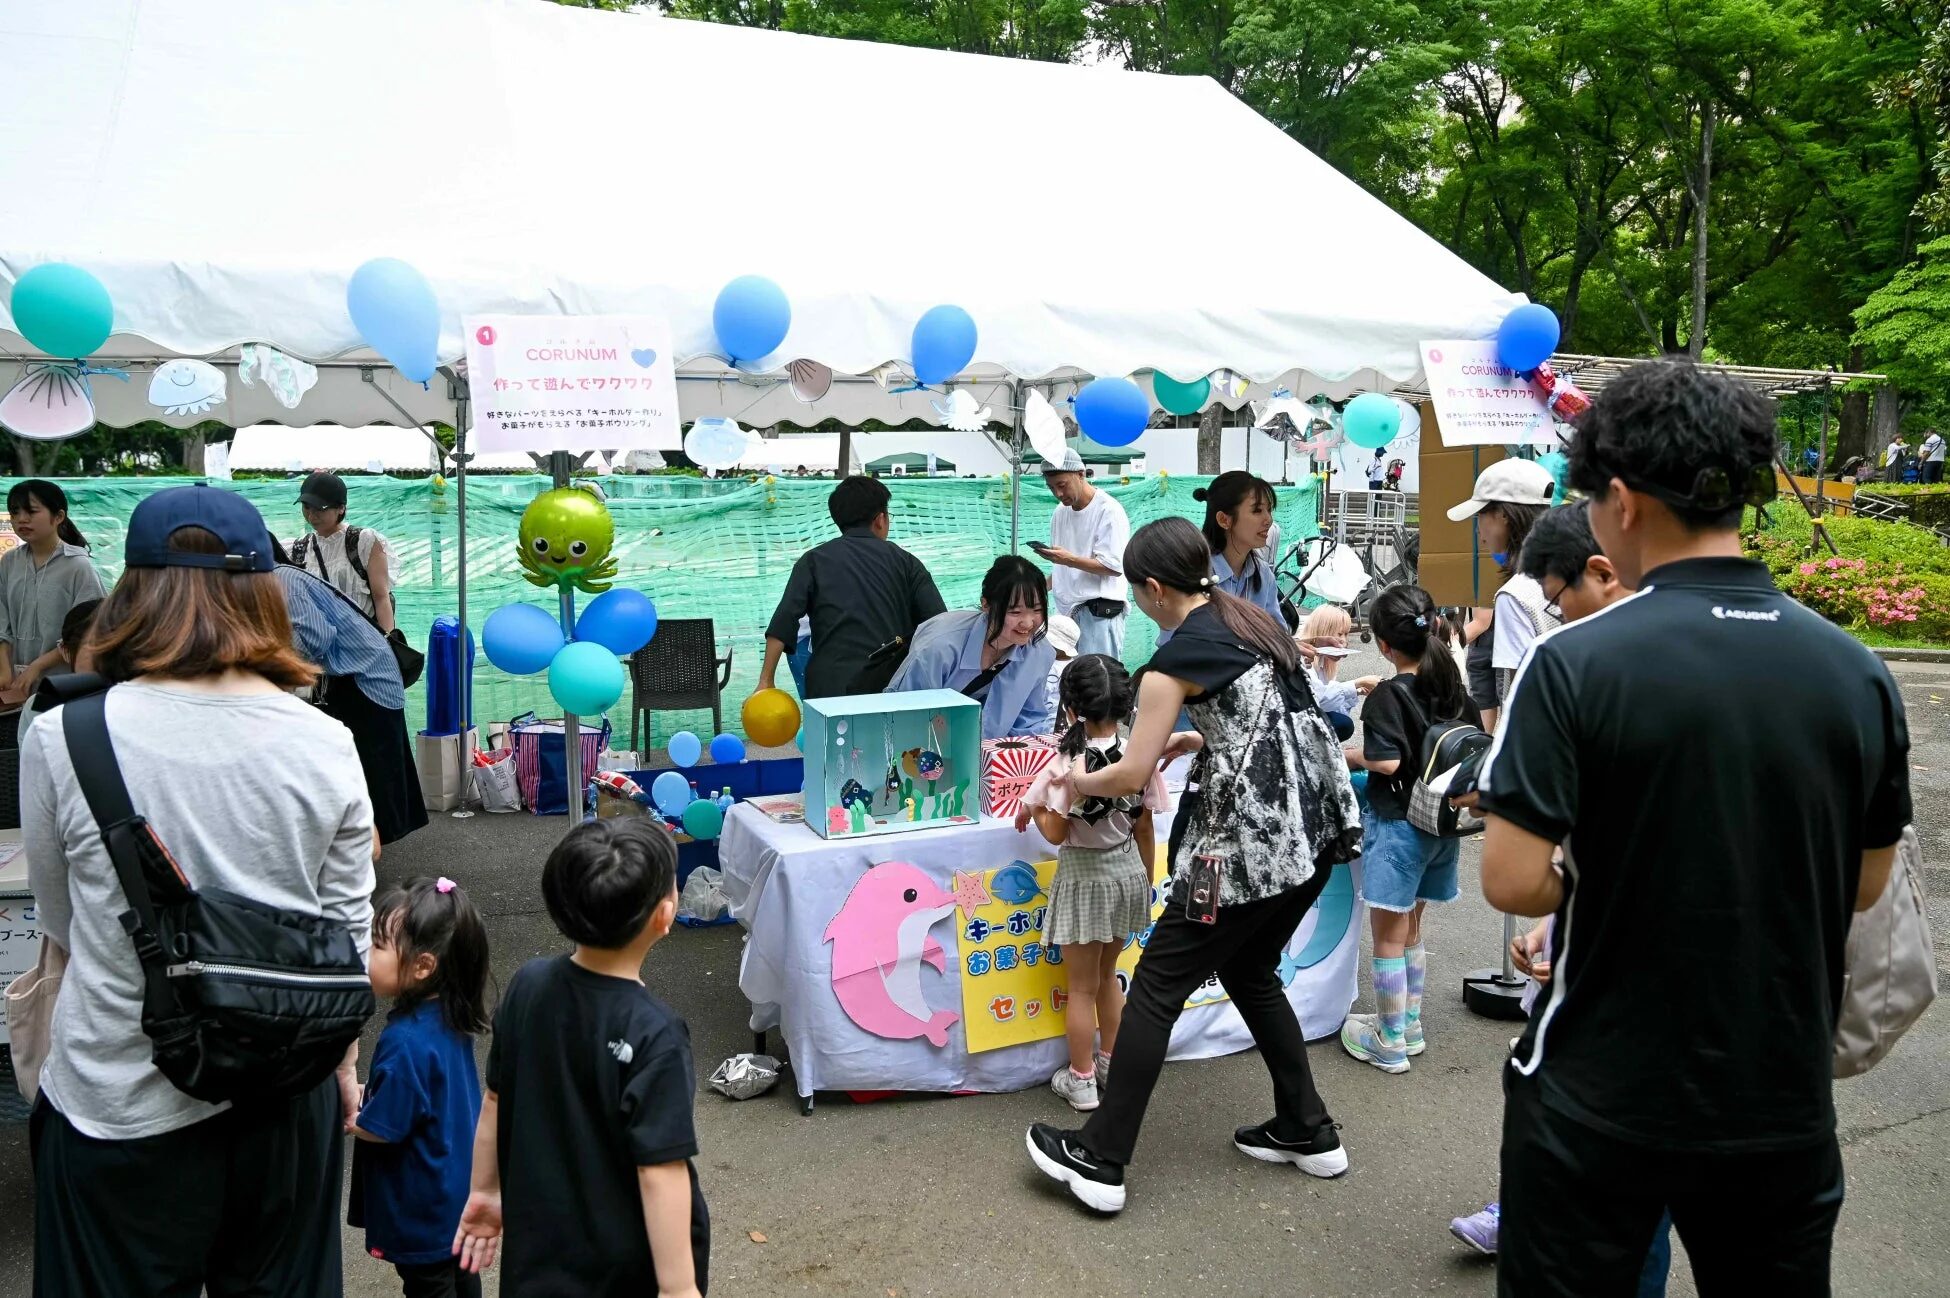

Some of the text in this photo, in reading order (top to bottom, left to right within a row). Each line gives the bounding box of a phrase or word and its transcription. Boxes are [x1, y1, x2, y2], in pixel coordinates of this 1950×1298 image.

[526, 348, 618, 361] CORUNUM
[1461, 365, 1513, 377] CORUNUM
[493, 376, 653, 392] 作って遊んでワクワク
[989, 987, 1069, 1022] セット
